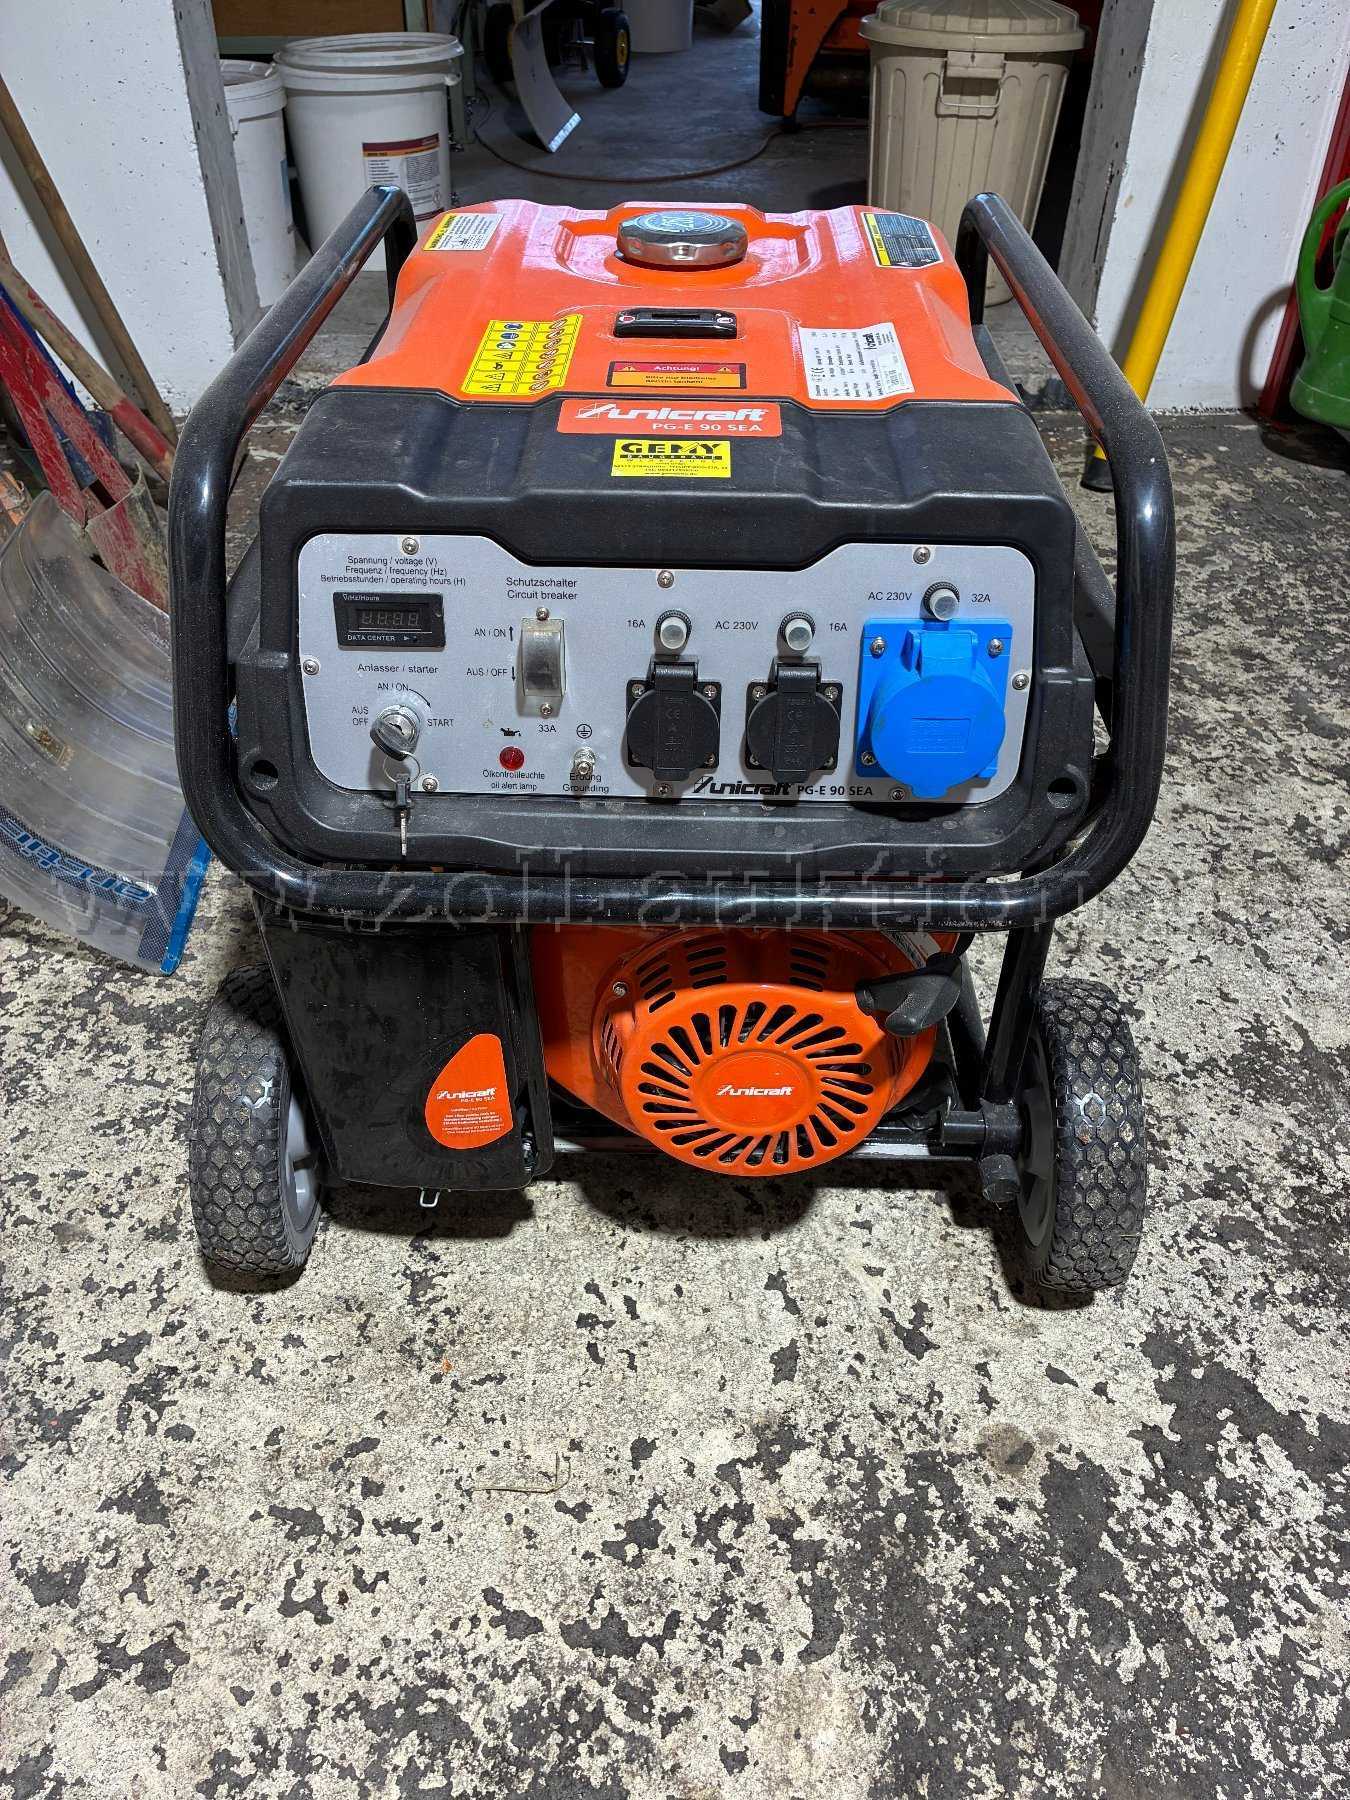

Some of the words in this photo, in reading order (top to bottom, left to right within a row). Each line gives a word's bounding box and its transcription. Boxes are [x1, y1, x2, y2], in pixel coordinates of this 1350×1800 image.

[652, 423, 694, 431] PG-E
[727, 424, 763, 432] SEA
[347, 556, 388, 565] Spannung
[395, 557, 423, 566] voltage
[425, 557, 438, 566] (V)
[345, 566, 382, 575] Frequenz
[389, 567, 428, 576] frequency
[430, 567, 448, 577] (Hz)
[320, 574, 384, 583] Betriebsstunden
[390, 576, 427, 586] operating
[429, 576, 452, 585] hours
[453, 577, 467, 586] (H)
[505, 576, 577, 588] Schutzschalter
[507, 589, 538, 599] Circuit
[540, 590, 578, 600] breaker
[868, 591, 884, 600] AC
[885, 591, 913, 602] 230V
[971, 593, 991, 603] 32A
[626, 619, 646, 629] 16A
[714, 620, 731, 630] AC
[732, 621, 759, 632] 230V
[828, 622, 848, 632] 16A
[474, 627, 486, 637] AN
[493, 628, 506, 638] ON
[357, 663, 400, 673] Anlasser
[408, 665, 439, 674] starter
[466, 667, 484, 677] AUS
[490, 668, 508, 677] OFF
[377, 682, 389, 691] AN
[397, 682, 409, 692] ON
[351, 706, 369, 715] AUS
[352, 717, 369, 726] OFF
[427, 718, 454, 727] START
[538, 724, 557, 733] 33A
[490, 781, 500, 790] oil
[501, 782, 519, 790] alert
[519, 783, 538, 792] lamp
[562, 783, 610, 794] Grounding
[796, 785, 826, 796] PG-E
[829, 785, 846, 796] 90
[848, 786, 873, 797] SEA
